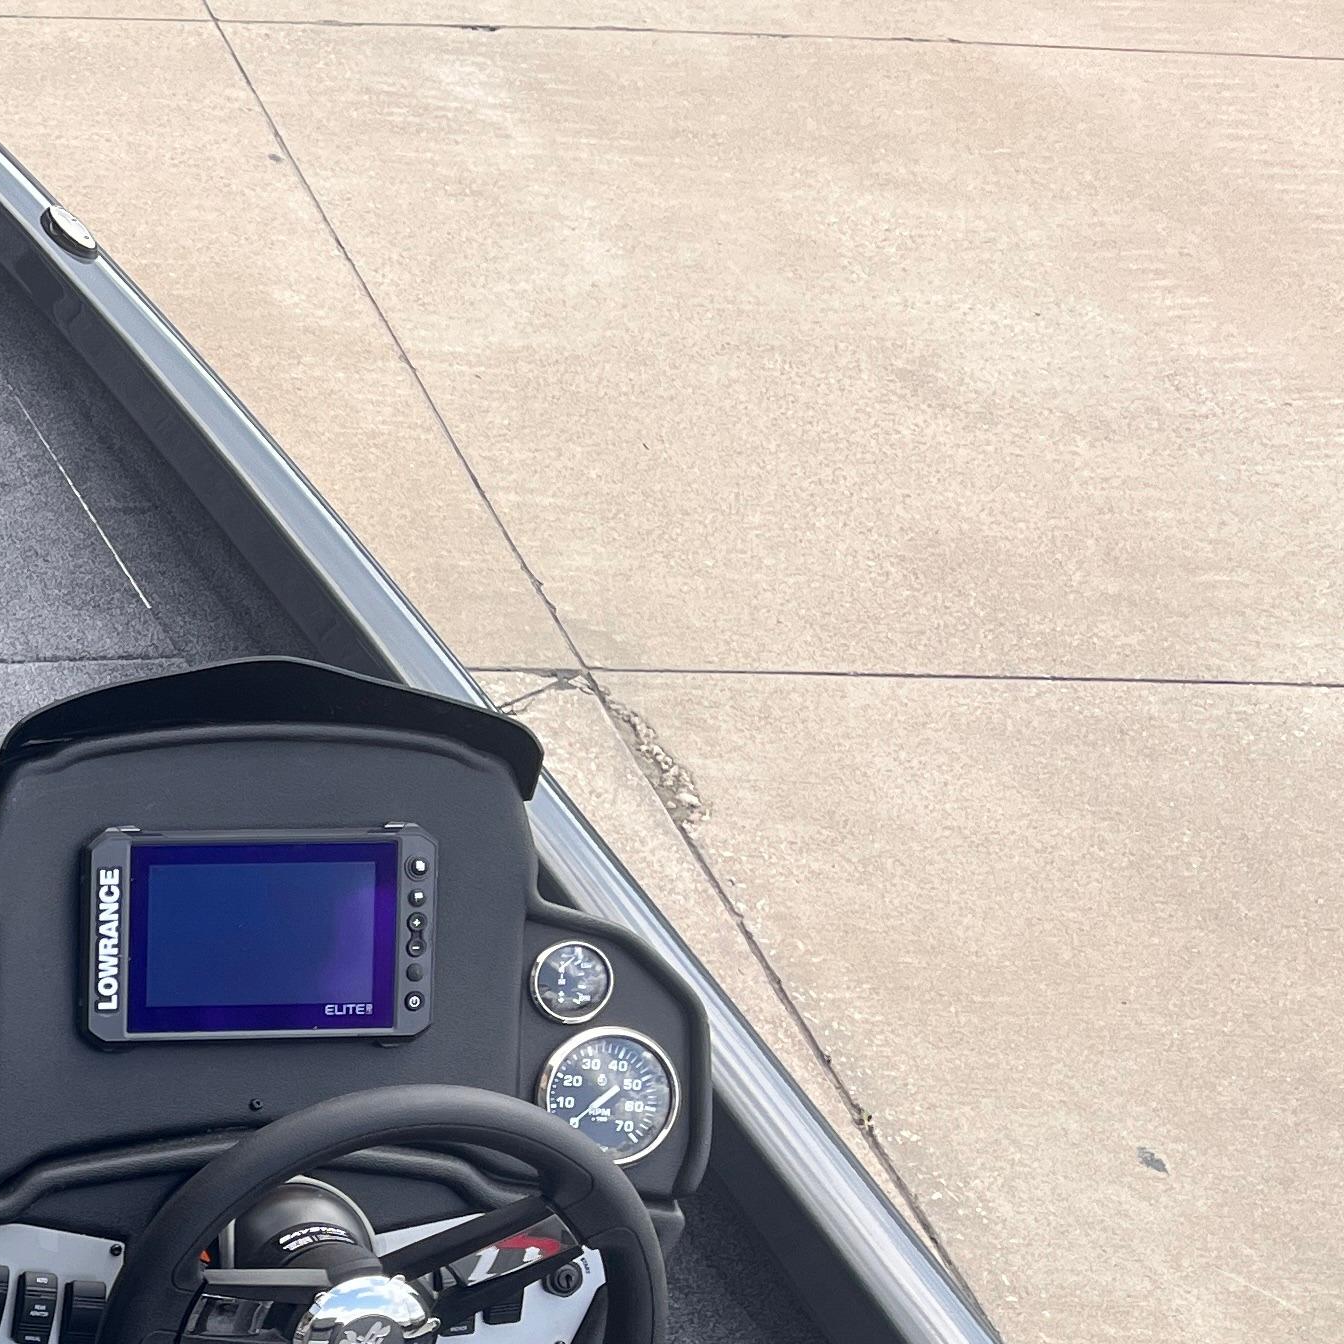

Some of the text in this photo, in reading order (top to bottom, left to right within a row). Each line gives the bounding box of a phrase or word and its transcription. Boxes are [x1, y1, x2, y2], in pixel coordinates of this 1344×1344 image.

[97, 868, 121, 1011] LOWRANCE
[324, 1003, 366, 1016] ELITE
[581, 1058, 602, 1071] 30
[608, 1059, 629, 1072] 40
[562, 1074, 583, 1087] 20
[623, 1078, 643, 1091] 50
[556, 1096, 575, 1109] 10
[624, 1100, 645, 1113] 60
[587, 1107, 612, 1117] RPM
[615, 1119, 634, 1133] 70
